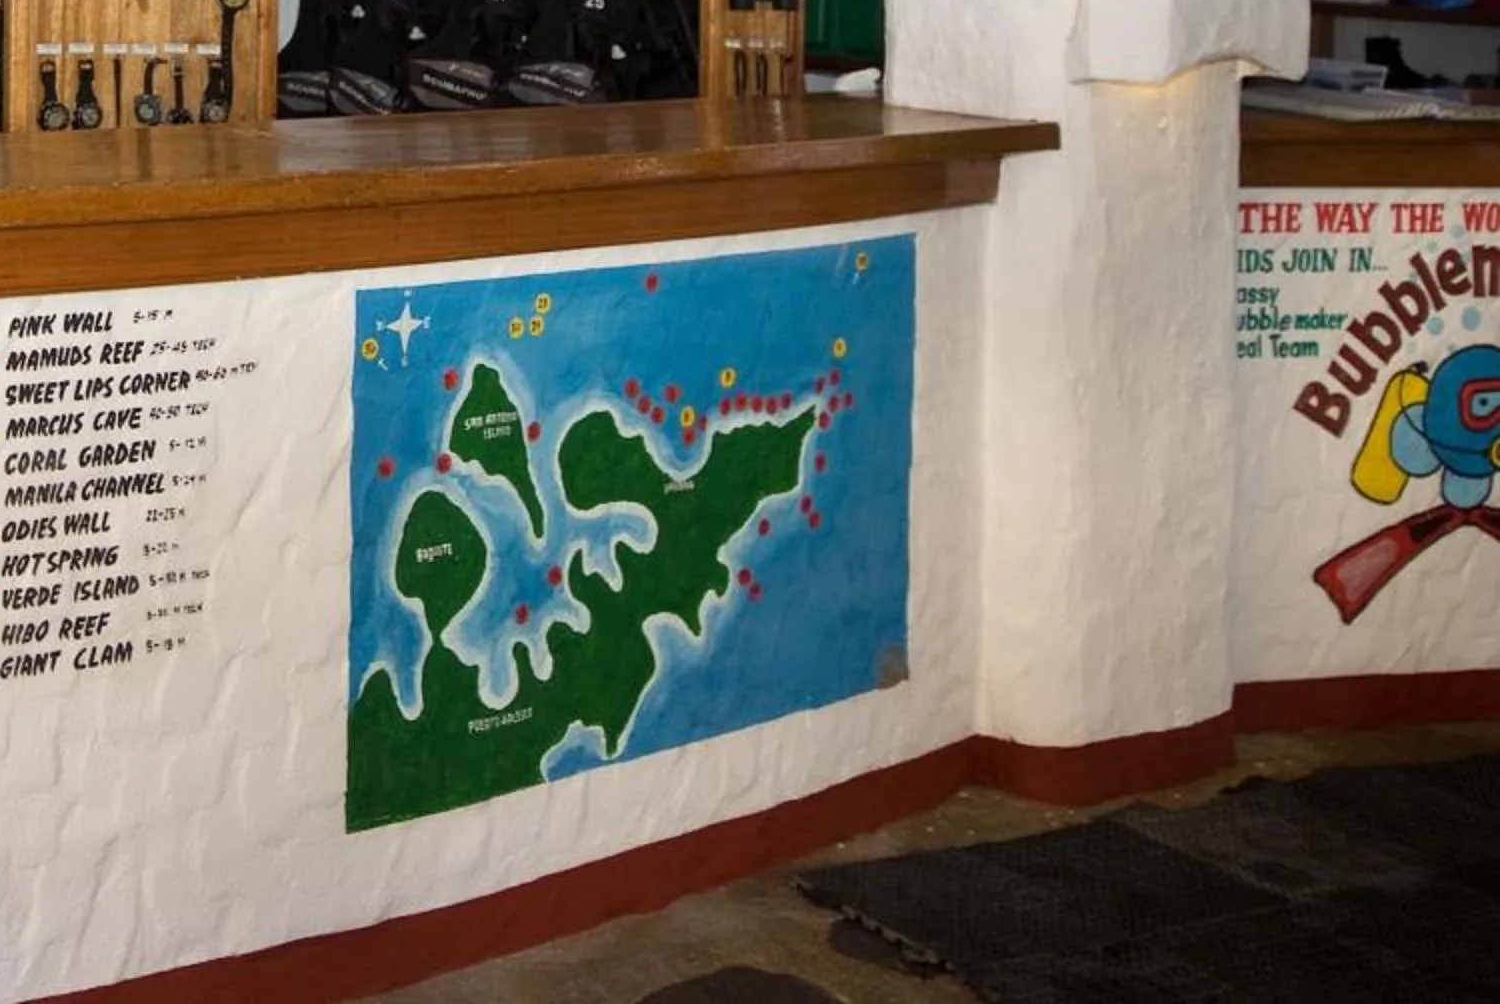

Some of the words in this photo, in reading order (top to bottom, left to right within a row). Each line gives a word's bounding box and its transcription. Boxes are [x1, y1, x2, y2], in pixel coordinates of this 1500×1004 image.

[1238, 202, 1302, 234] THE
[1314, 202, 1378, 233] WAY
[1391, 203, 1445, 234] THE
[1282, 248, 1338, 273] JOIN
[8, 314, 57, 338] PINK
[63, 311, 113, 334] WALL
[5, 344, 92, 372] MAMUDS
[100, 340, 145, 365] REEF
[1269, 333, 1319, 357] Team
[5, 380, 70, 406] SWEET
[73, 376, 114, 401] LIPS
[118, 369, 191, 396] CORNER
[6, 412, 84, 440] MARCUS
[93, 407, 143, 432] CAVE
[4, 448, 67, 475] CORAL
[78, 440, 156, 468] GARDEN
[4, 480, 78, 508] MANILA
[81, 472, 165, 501] CHANNEL
[1, 516, 57, 543] ODIES
[64, 511, 111, 535] WALL
[2, 583, 62, 610] VERDE
[73, 575, 140, 603] ISLAND
[1, 619, 50, 646] HIBO
[58, 612, 111, 640] REEF
[0, 649, 62, 680] GIANT
[73, 641, 133, 671] CLAM
